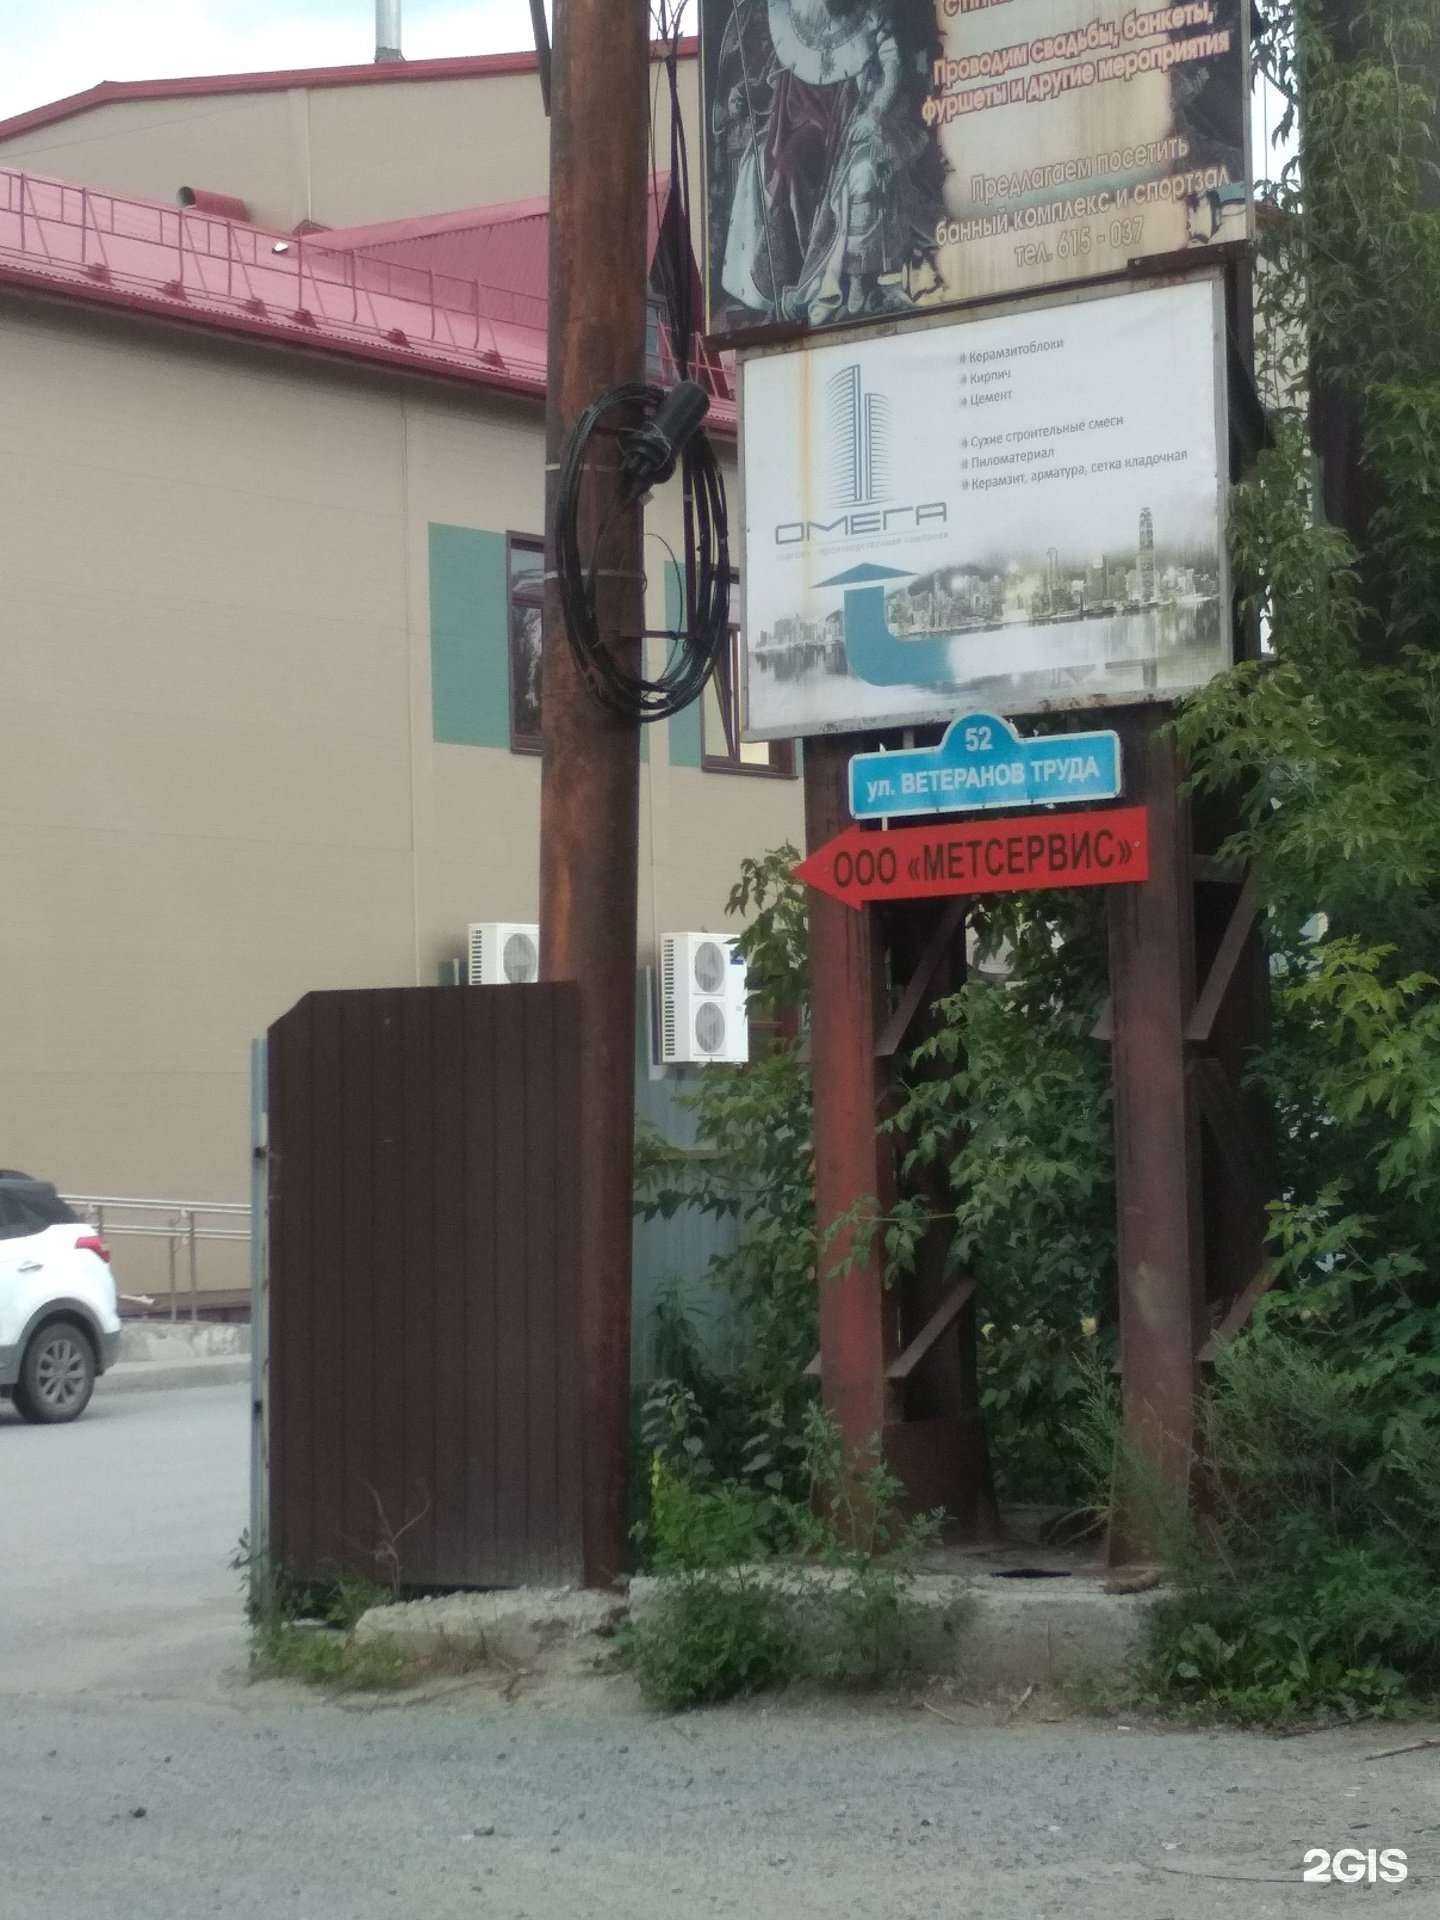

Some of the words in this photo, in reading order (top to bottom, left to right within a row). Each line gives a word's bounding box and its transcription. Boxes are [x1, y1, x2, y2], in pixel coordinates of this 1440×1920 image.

[933, 42, 1029, 88] Проводим
[1029, 18, 1120, 63] свадьбы,
[1122, 2, 1215, 41] банкеты,
[921, 81, 1009, 127] фуршеты
[1009, 77, 1026, 103] и
[1025, 62, 1096, 104] другие
[1097, 30, 1231, 82] мероприятия
[971, 155, 1093, 206] Предлагаем
[1097, 136, 1190, 175] посетить
[935, 205, 1009, 247] банный
[1013, 190, 1111, 231] комплекс
[1115, 187, 1129, 209] и
[1134, 164, 1231, 205] спортзал
[1014, 241, 1053, 268] тел.
[1057, 226, 1091, 258] 615
[1110, 216, 1145, 248] 037
[968, 338, 1065, 364] Керамзитоблоки
[969, 369, 1012, 385] Кирпич
[970, 390, 1013, 407] Цемент
[969, 434, 1003, 448] Сухие
[1005, 421, 1086, 443] строительные
[1088, 415, 1124, 429] смеси
[971, 449, 1055, 469] Пиломатериал
[1090, 458, 1122, 473] сетка
[1124, 449, 1189, 468] кладочная
[775, 502, 947, 545] ОМЕГА
[965, 727, 993, 750] 52
[867, 779, 896, 802] ул.
[901, 763, 1025, 794] ВЕТЕРАНОВ
[1031, 756, 1100, 783] ТРУДА
[833, 847, 897, 888] ООО
[907, 829, 1133, 881] «МЕТСЕРВИС»
